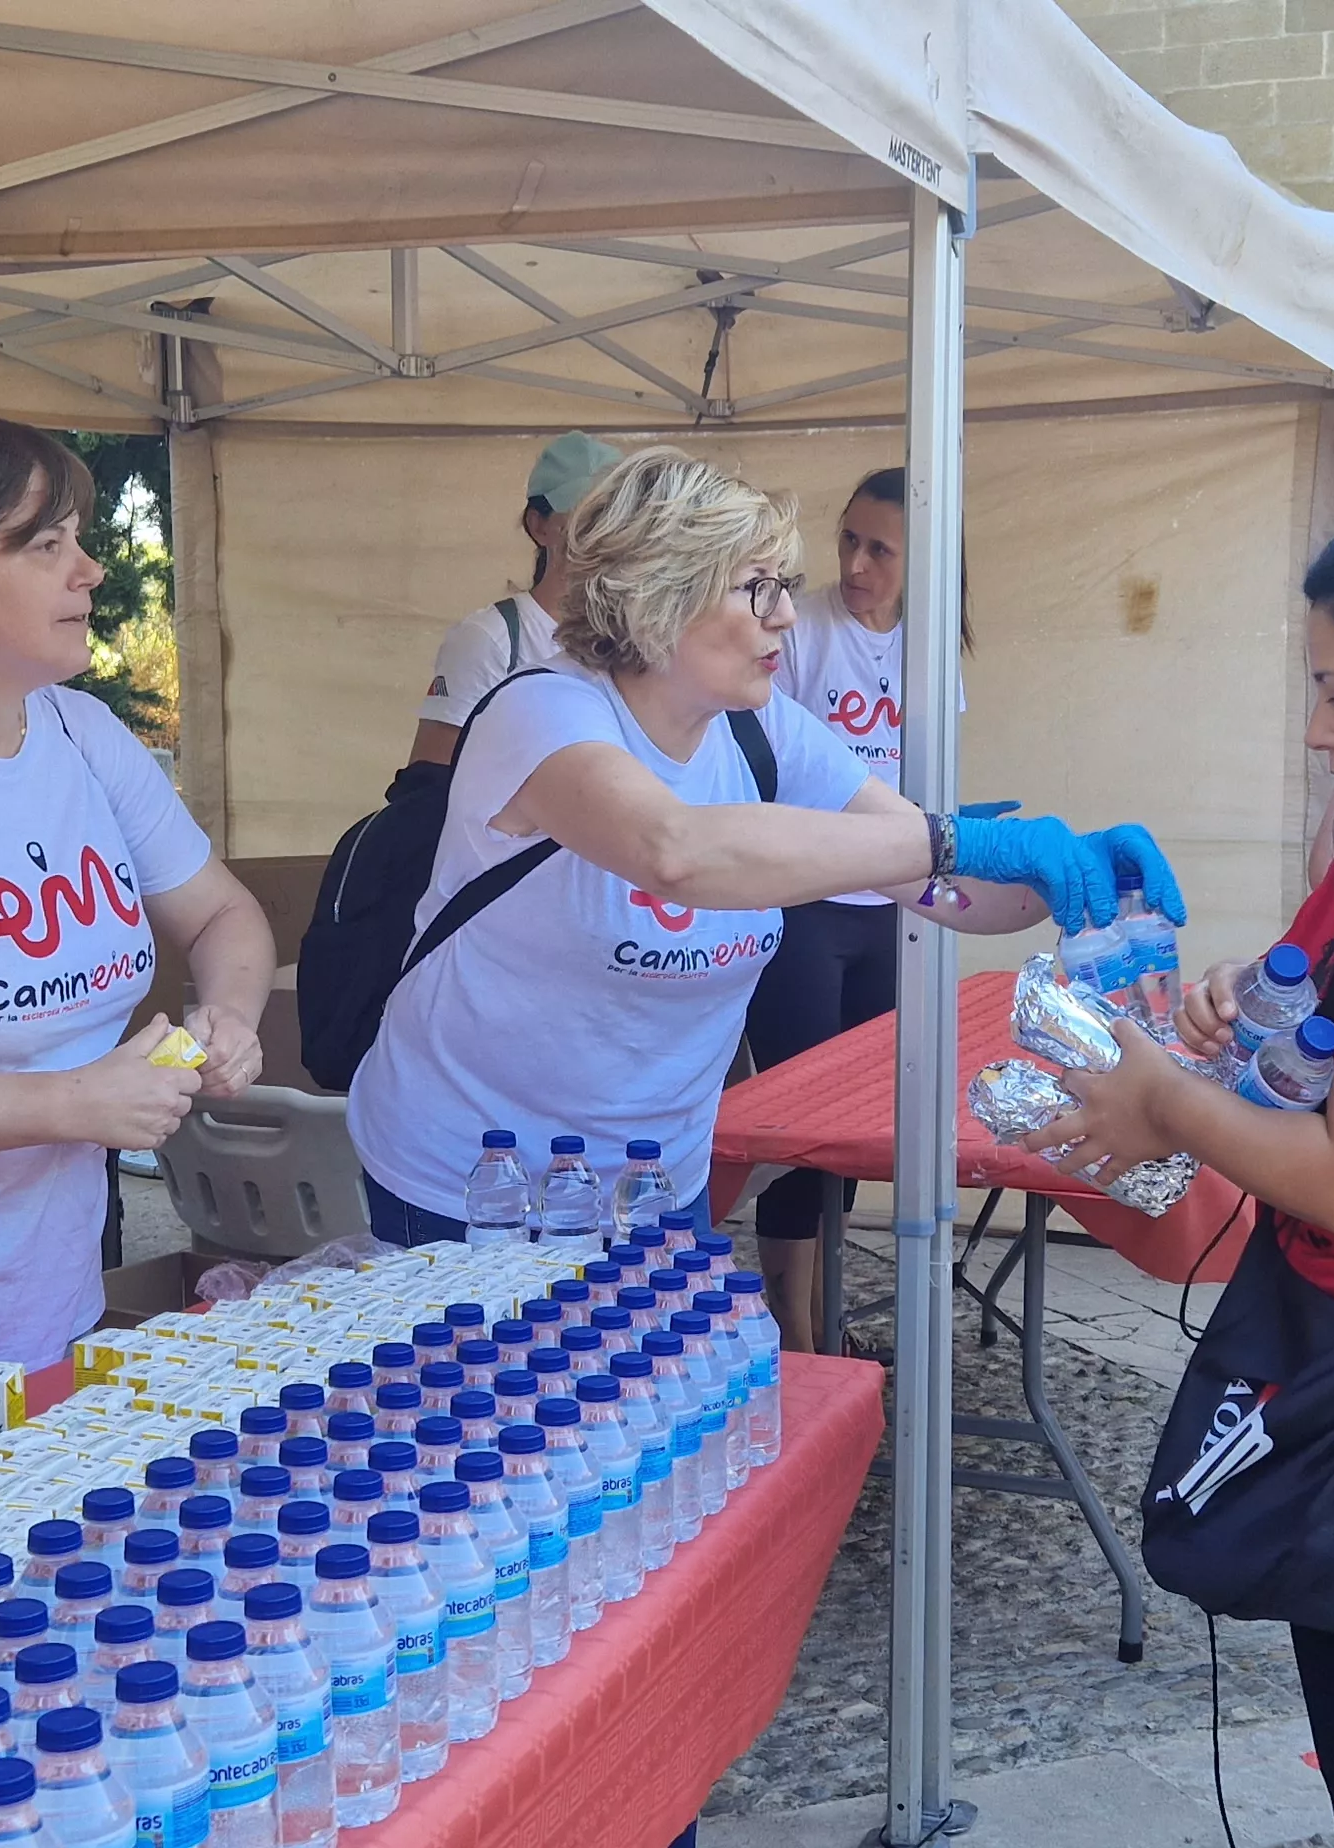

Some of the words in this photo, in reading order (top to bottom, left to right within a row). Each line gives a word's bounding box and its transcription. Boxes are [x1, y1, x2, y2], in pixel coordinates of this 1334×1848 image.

[888, 134, 943, 188] MASTERTENT
[7, 1014, 18, 1023] la
[602, 1475, 633, 1492] abras
[397, 1630, 434, 1650] abras
[331, 1673, 365, 1688] abras
